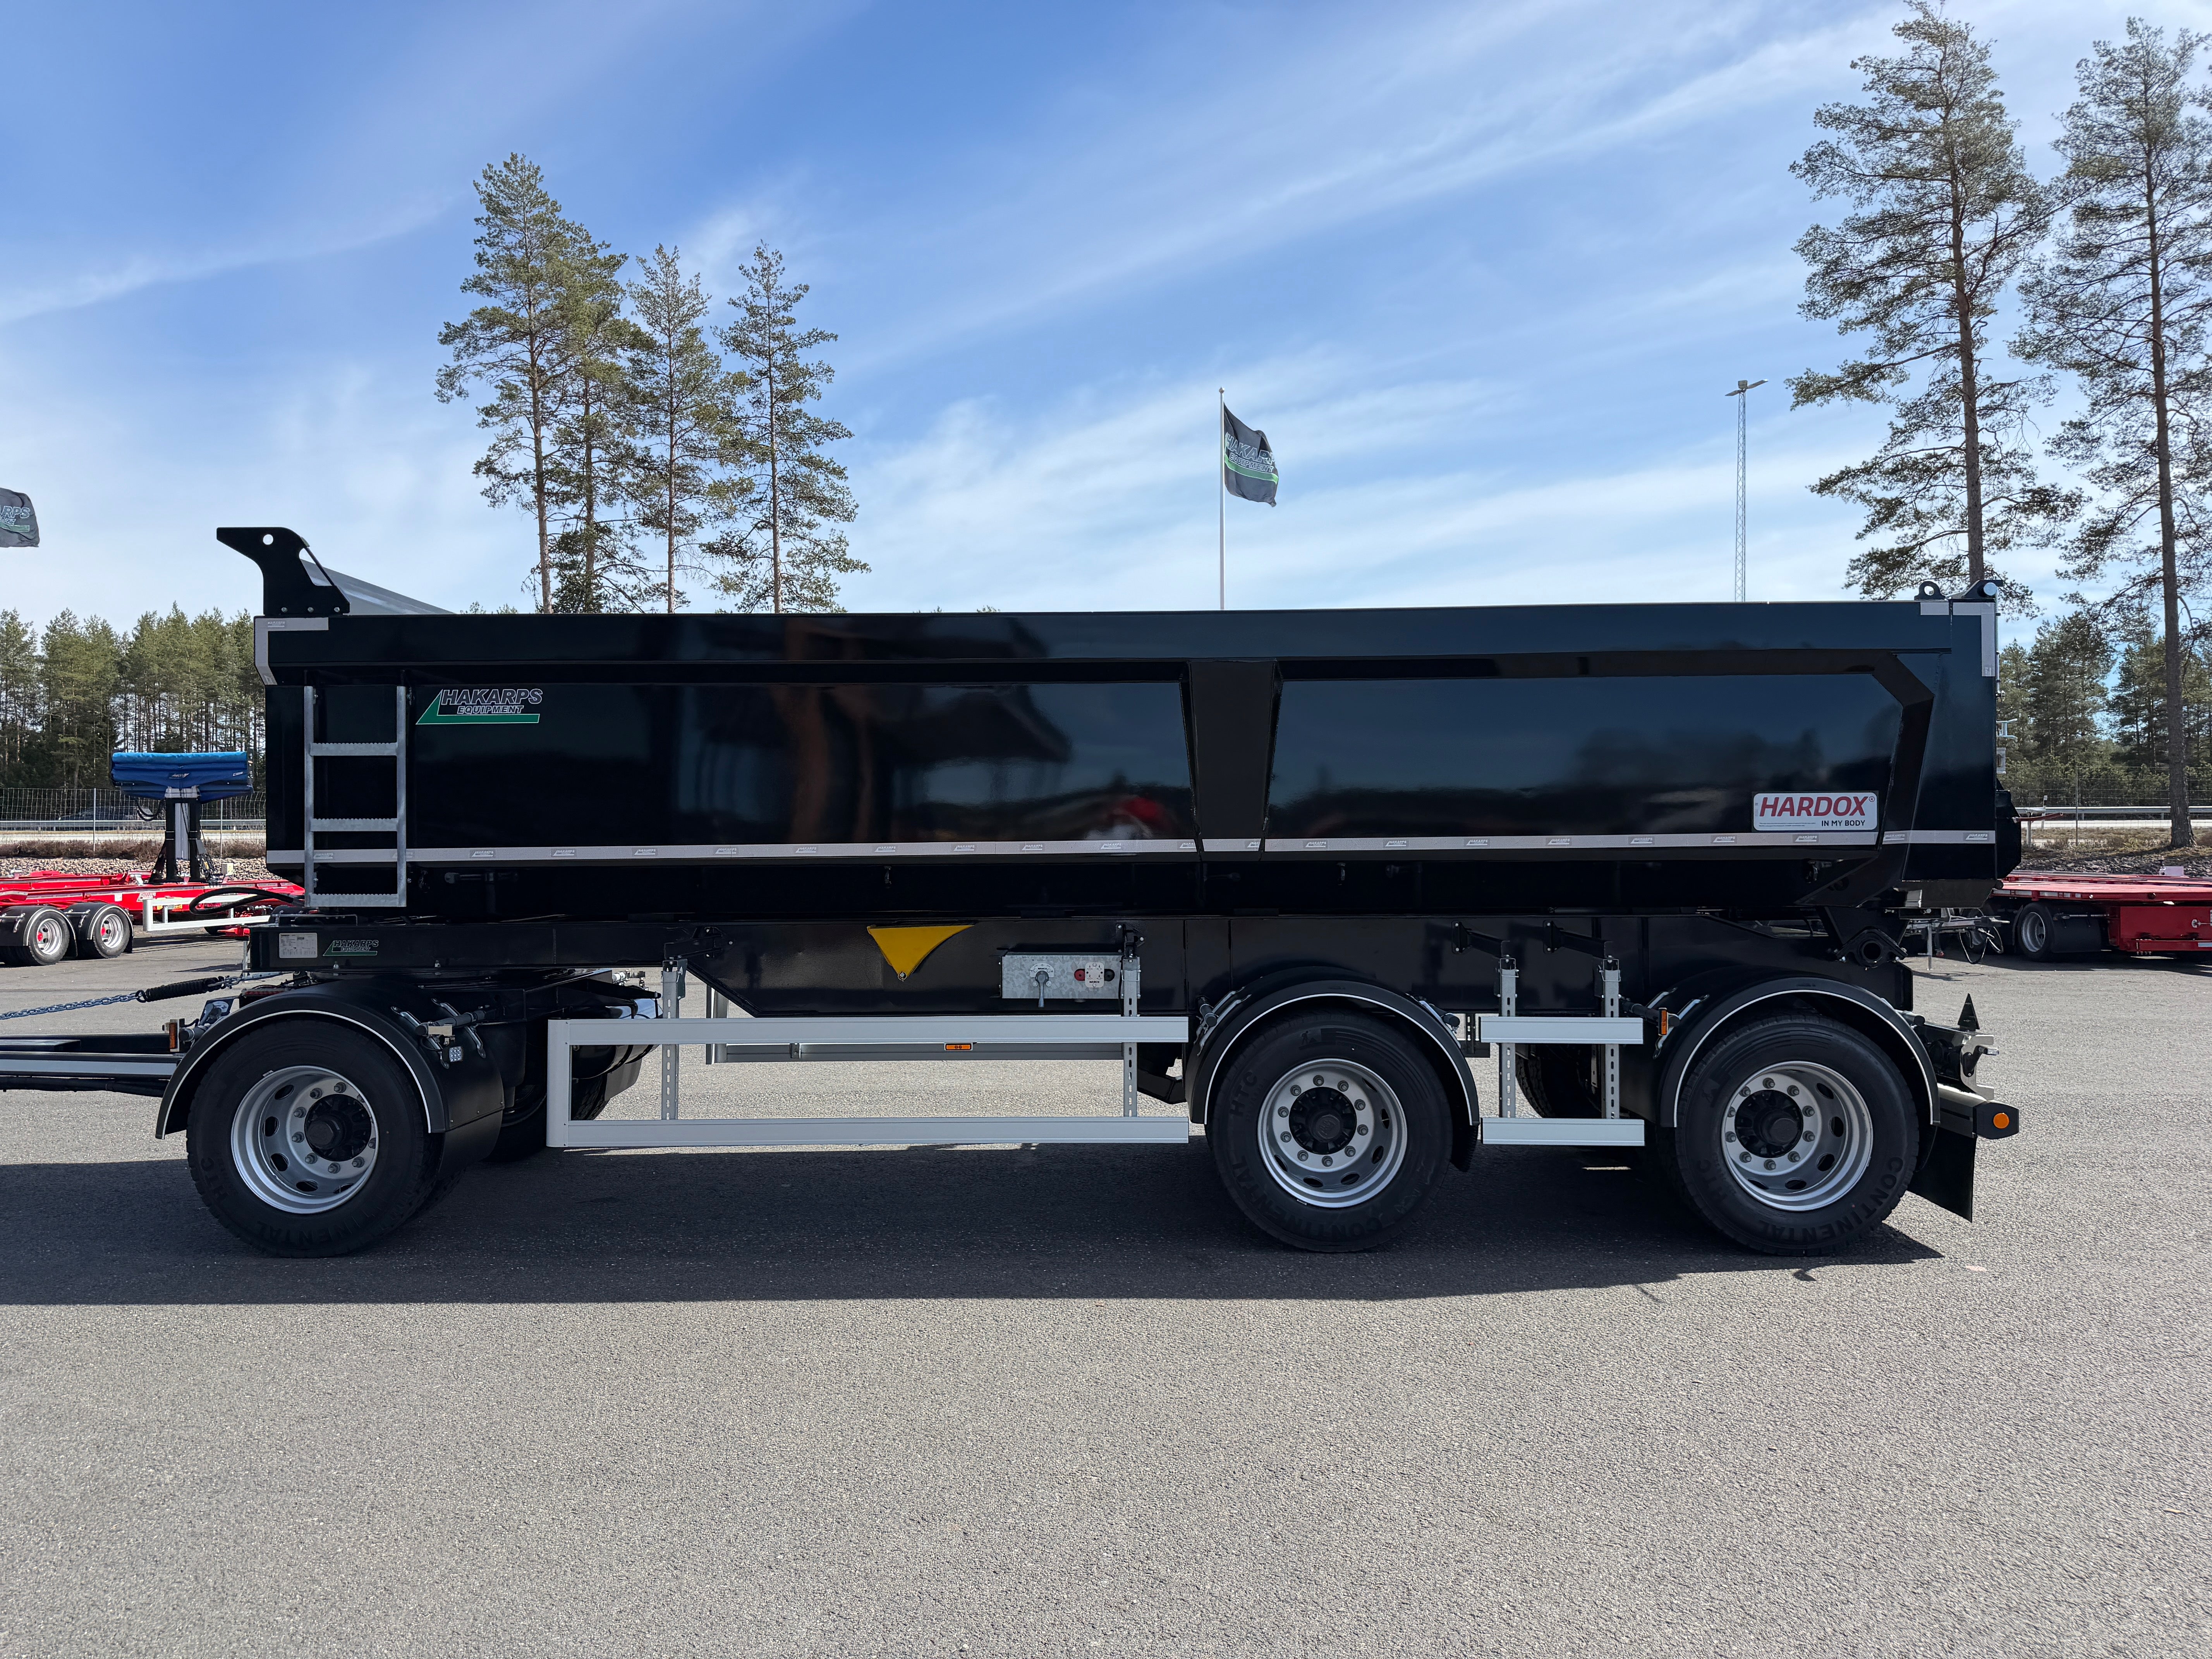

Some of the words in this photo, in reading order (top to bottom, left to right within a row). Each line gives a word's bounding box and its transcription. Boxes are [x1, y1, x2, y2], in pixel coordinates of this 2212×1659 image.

[441, 689, 543, 705] HAKARPS
[457, 705, 524, 714] EQUIPMENT
[1229, 1070, 1257, 1116] HTC
[1231, 1154, 1382, 1238] CONTINENTAL
[1759, 1156, 1903, 1241] CONTINENTAL
